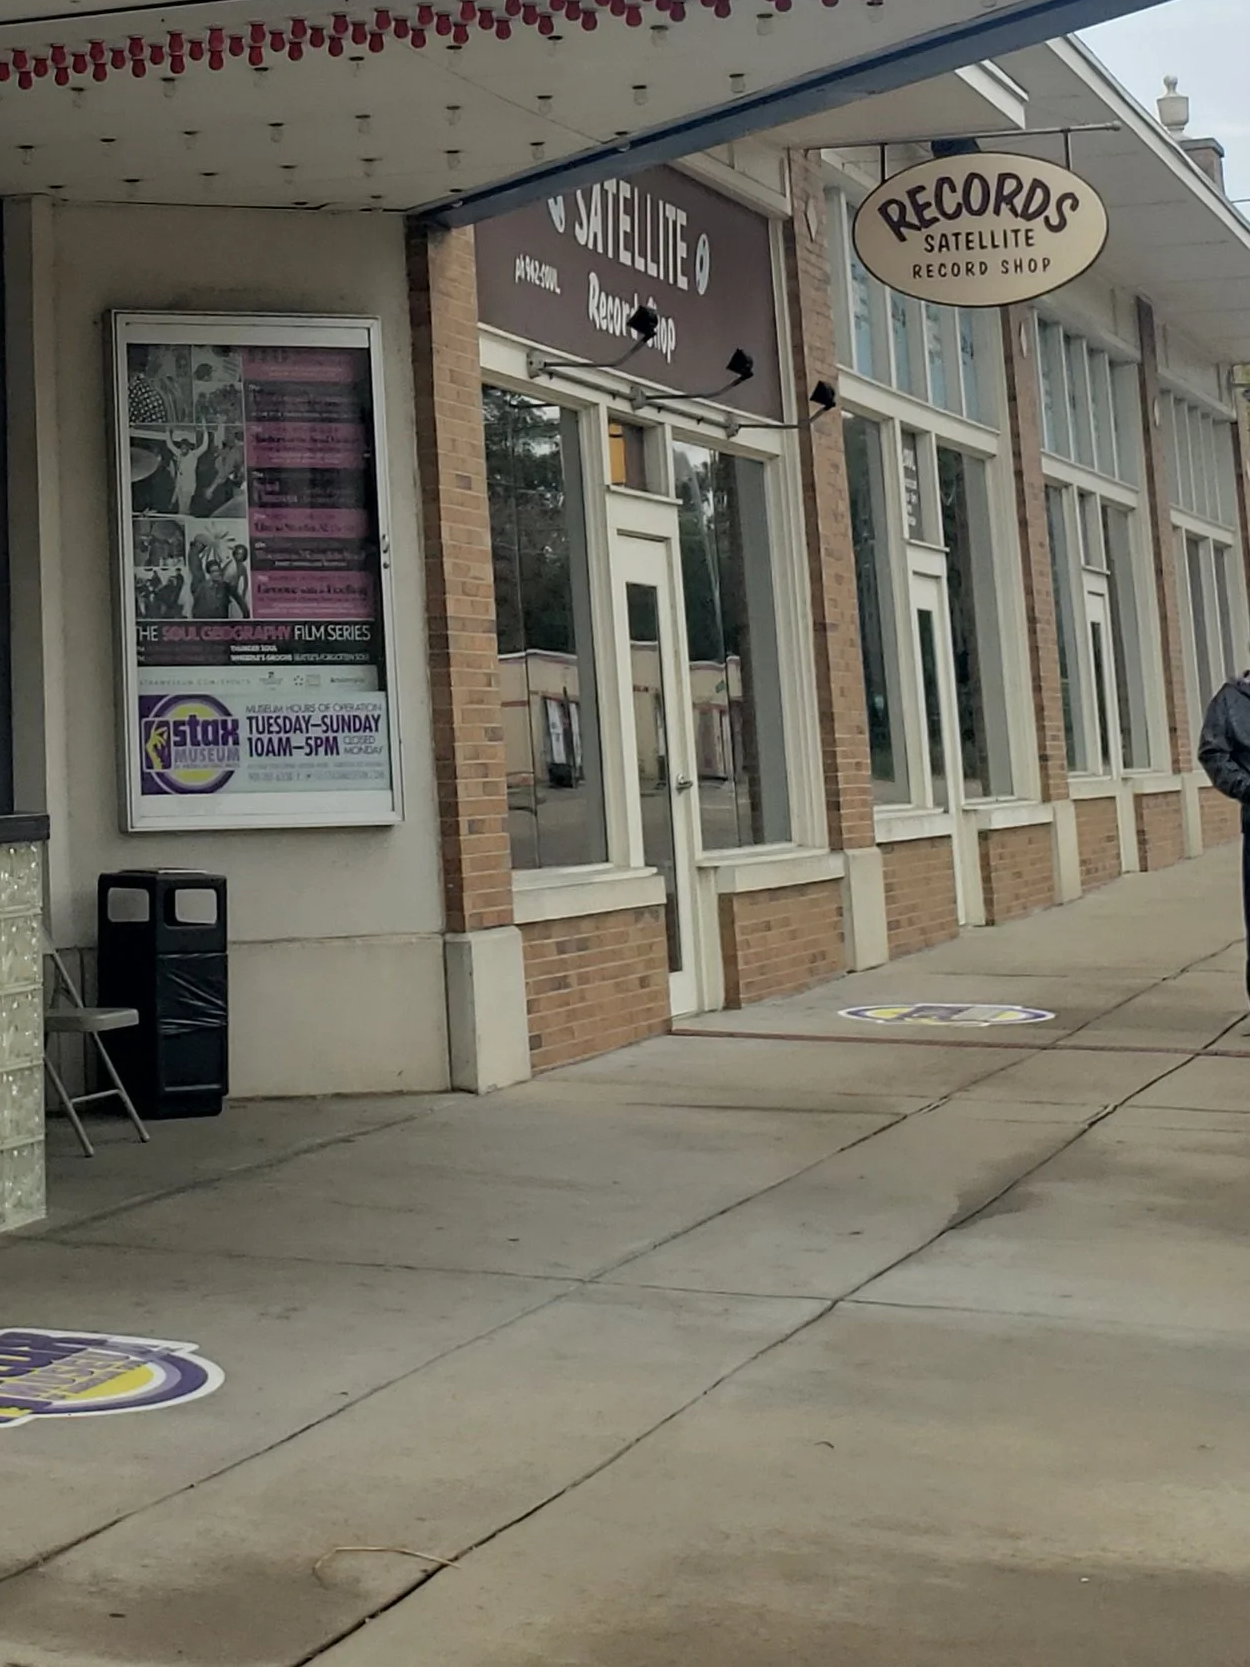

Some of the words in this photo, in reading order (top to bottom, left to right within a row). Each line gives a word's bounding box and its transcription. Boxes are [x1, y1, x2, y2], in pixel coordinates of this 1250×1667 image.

[877, 172, 1080, 242] RECORDS
[574, 177, 689, 291] SATELLITE
[924, 228, 1036, 253] SATELLITE
[912, 261, 989, 279] RECORD
[1000, 256, 1052, 274] SHOP
[162, 625, 199, 642] SOUL
[201, 625, 292, 642] GEOGRAPHY
[294, 625, 325, 641] FILM
[327, 625, 371, 641] SERIES
[246, 704, 283, 713] MUSEUM
[286, 703, 315, 713] HOURS
[318, 703, 330, 712] OF
[333, 702, 382, 712] OPERATION
[173, 714, 240, 747] stax
[343, 735, 376, 745] CLOSED
[174, 747, 240, 763] MUSEUM
[343, 746, 383, 756] MONDAY
